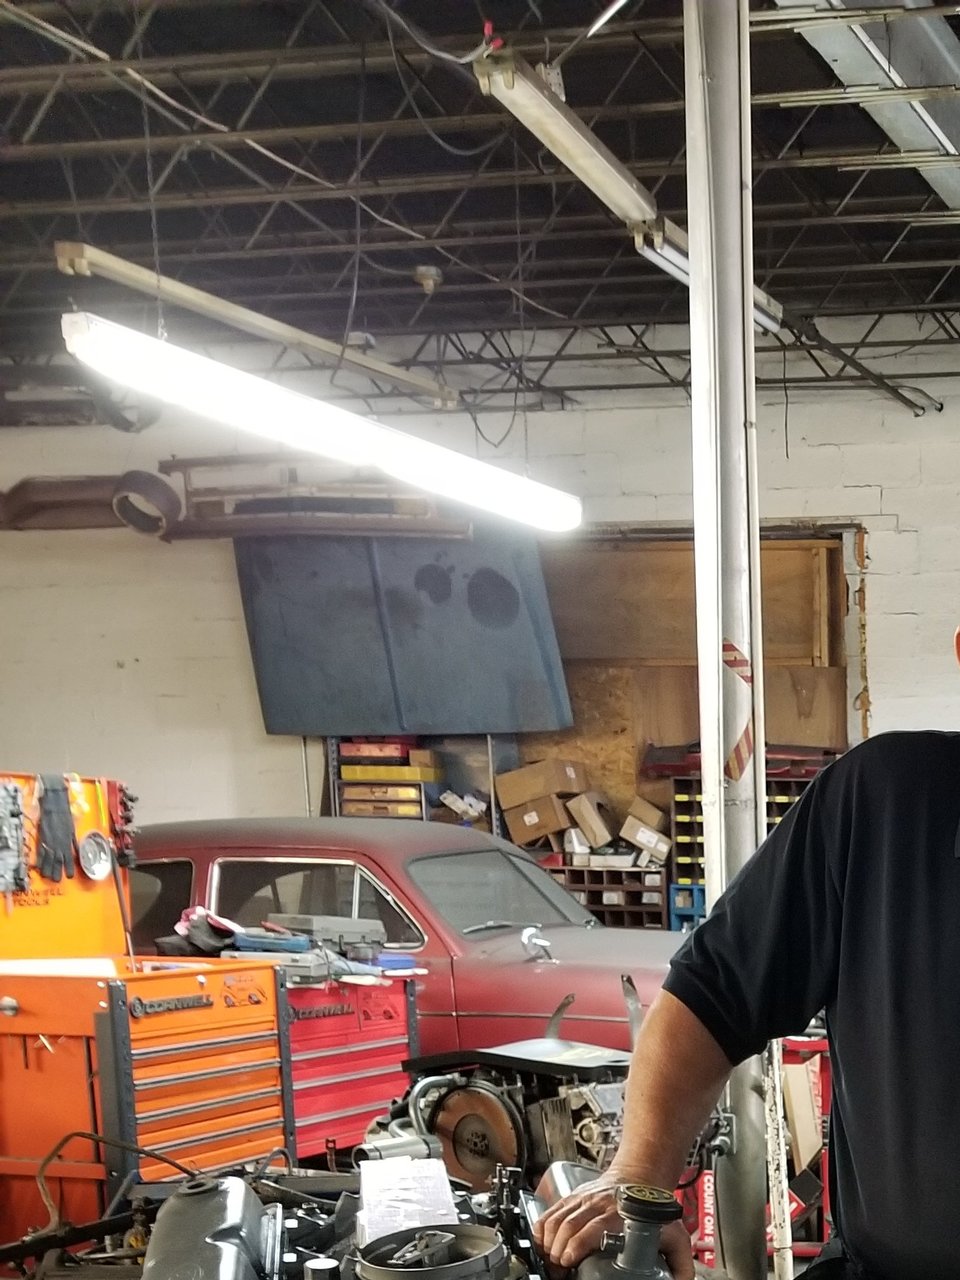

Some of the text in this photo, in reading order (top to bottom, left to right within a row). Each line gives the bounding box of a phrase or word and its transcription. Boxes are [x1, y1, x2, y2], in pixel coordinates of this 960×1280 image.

[145, 994, 214, 1014] CORNWELL
[703, 1175, 715, 1215] COUNT
[703, 1215, 715, 1234] ON
